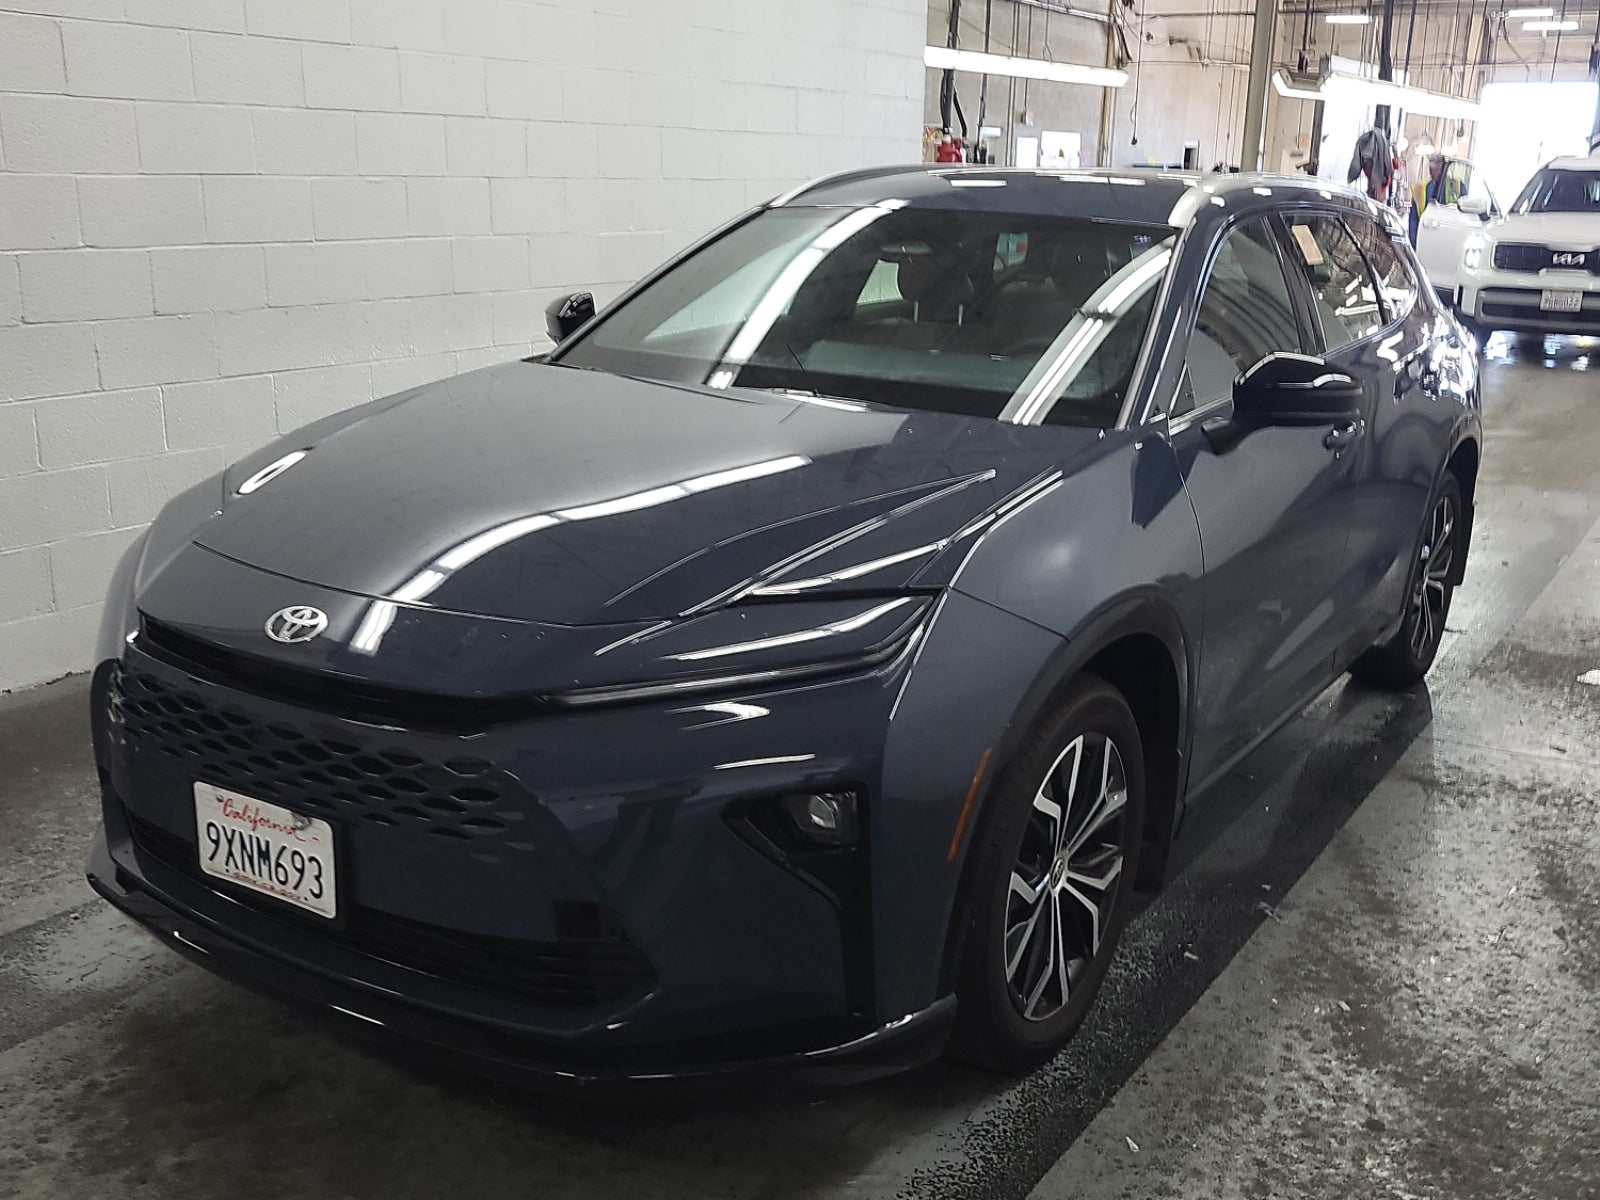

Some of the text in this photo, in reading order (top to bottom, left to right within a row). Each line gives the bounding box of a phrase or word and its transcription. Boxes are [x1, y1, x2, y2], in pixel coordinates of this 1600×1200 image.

[1552, 252, 1585, 265] KIA
[222, 798, 306, 842] California
[206, 821, 323, 899] 9XNM693
